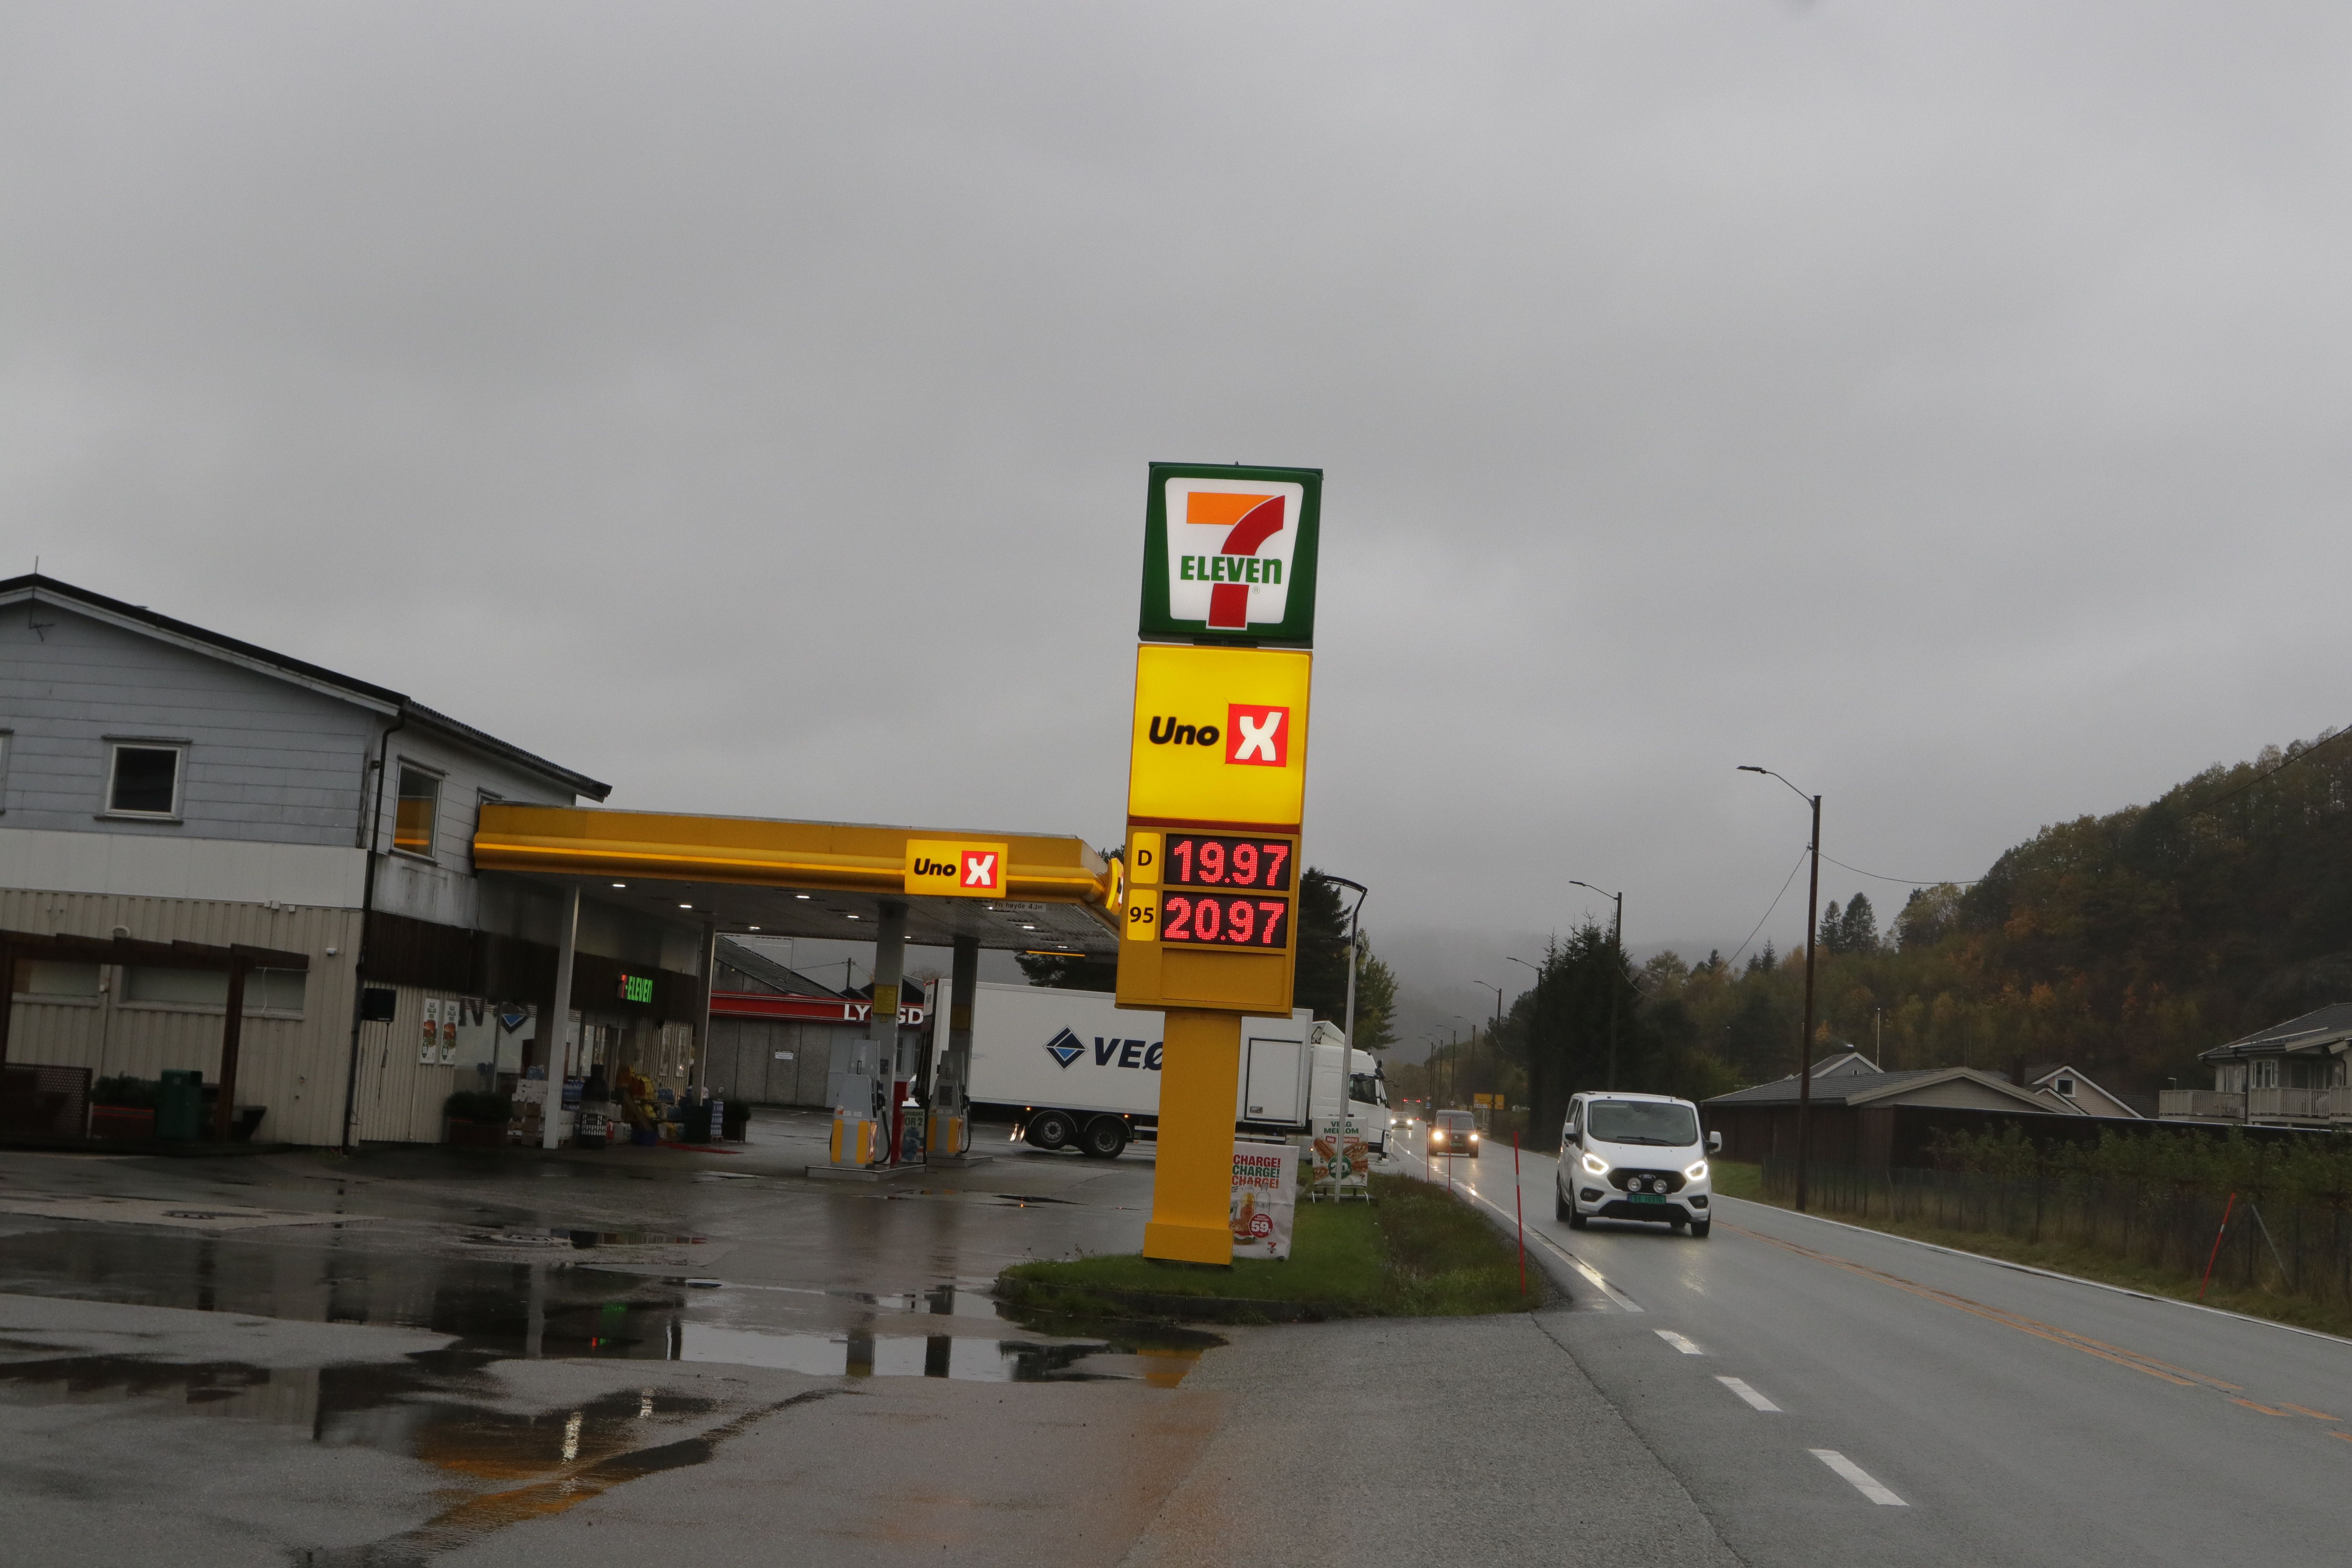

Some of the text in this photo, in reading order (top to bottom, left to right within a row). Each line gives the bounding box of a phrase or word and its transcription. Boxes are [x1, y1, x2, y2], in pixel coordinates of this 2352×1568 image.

[1149, 711, 1283, 761] Uno X
[913, 855, 995, 885] Uno X
[1138, 840, 1288, 886] D 19.97
[1129, 897, 1285, 944] 95 20.97
[918, 1117, 923, 1126] 2
[1232, 1165, 1280, 1178] CHARGE!
[1233, 1154, 1281, 1168] CHARGE!
[1231, 1175, 1279, 1189] CHARGE!
